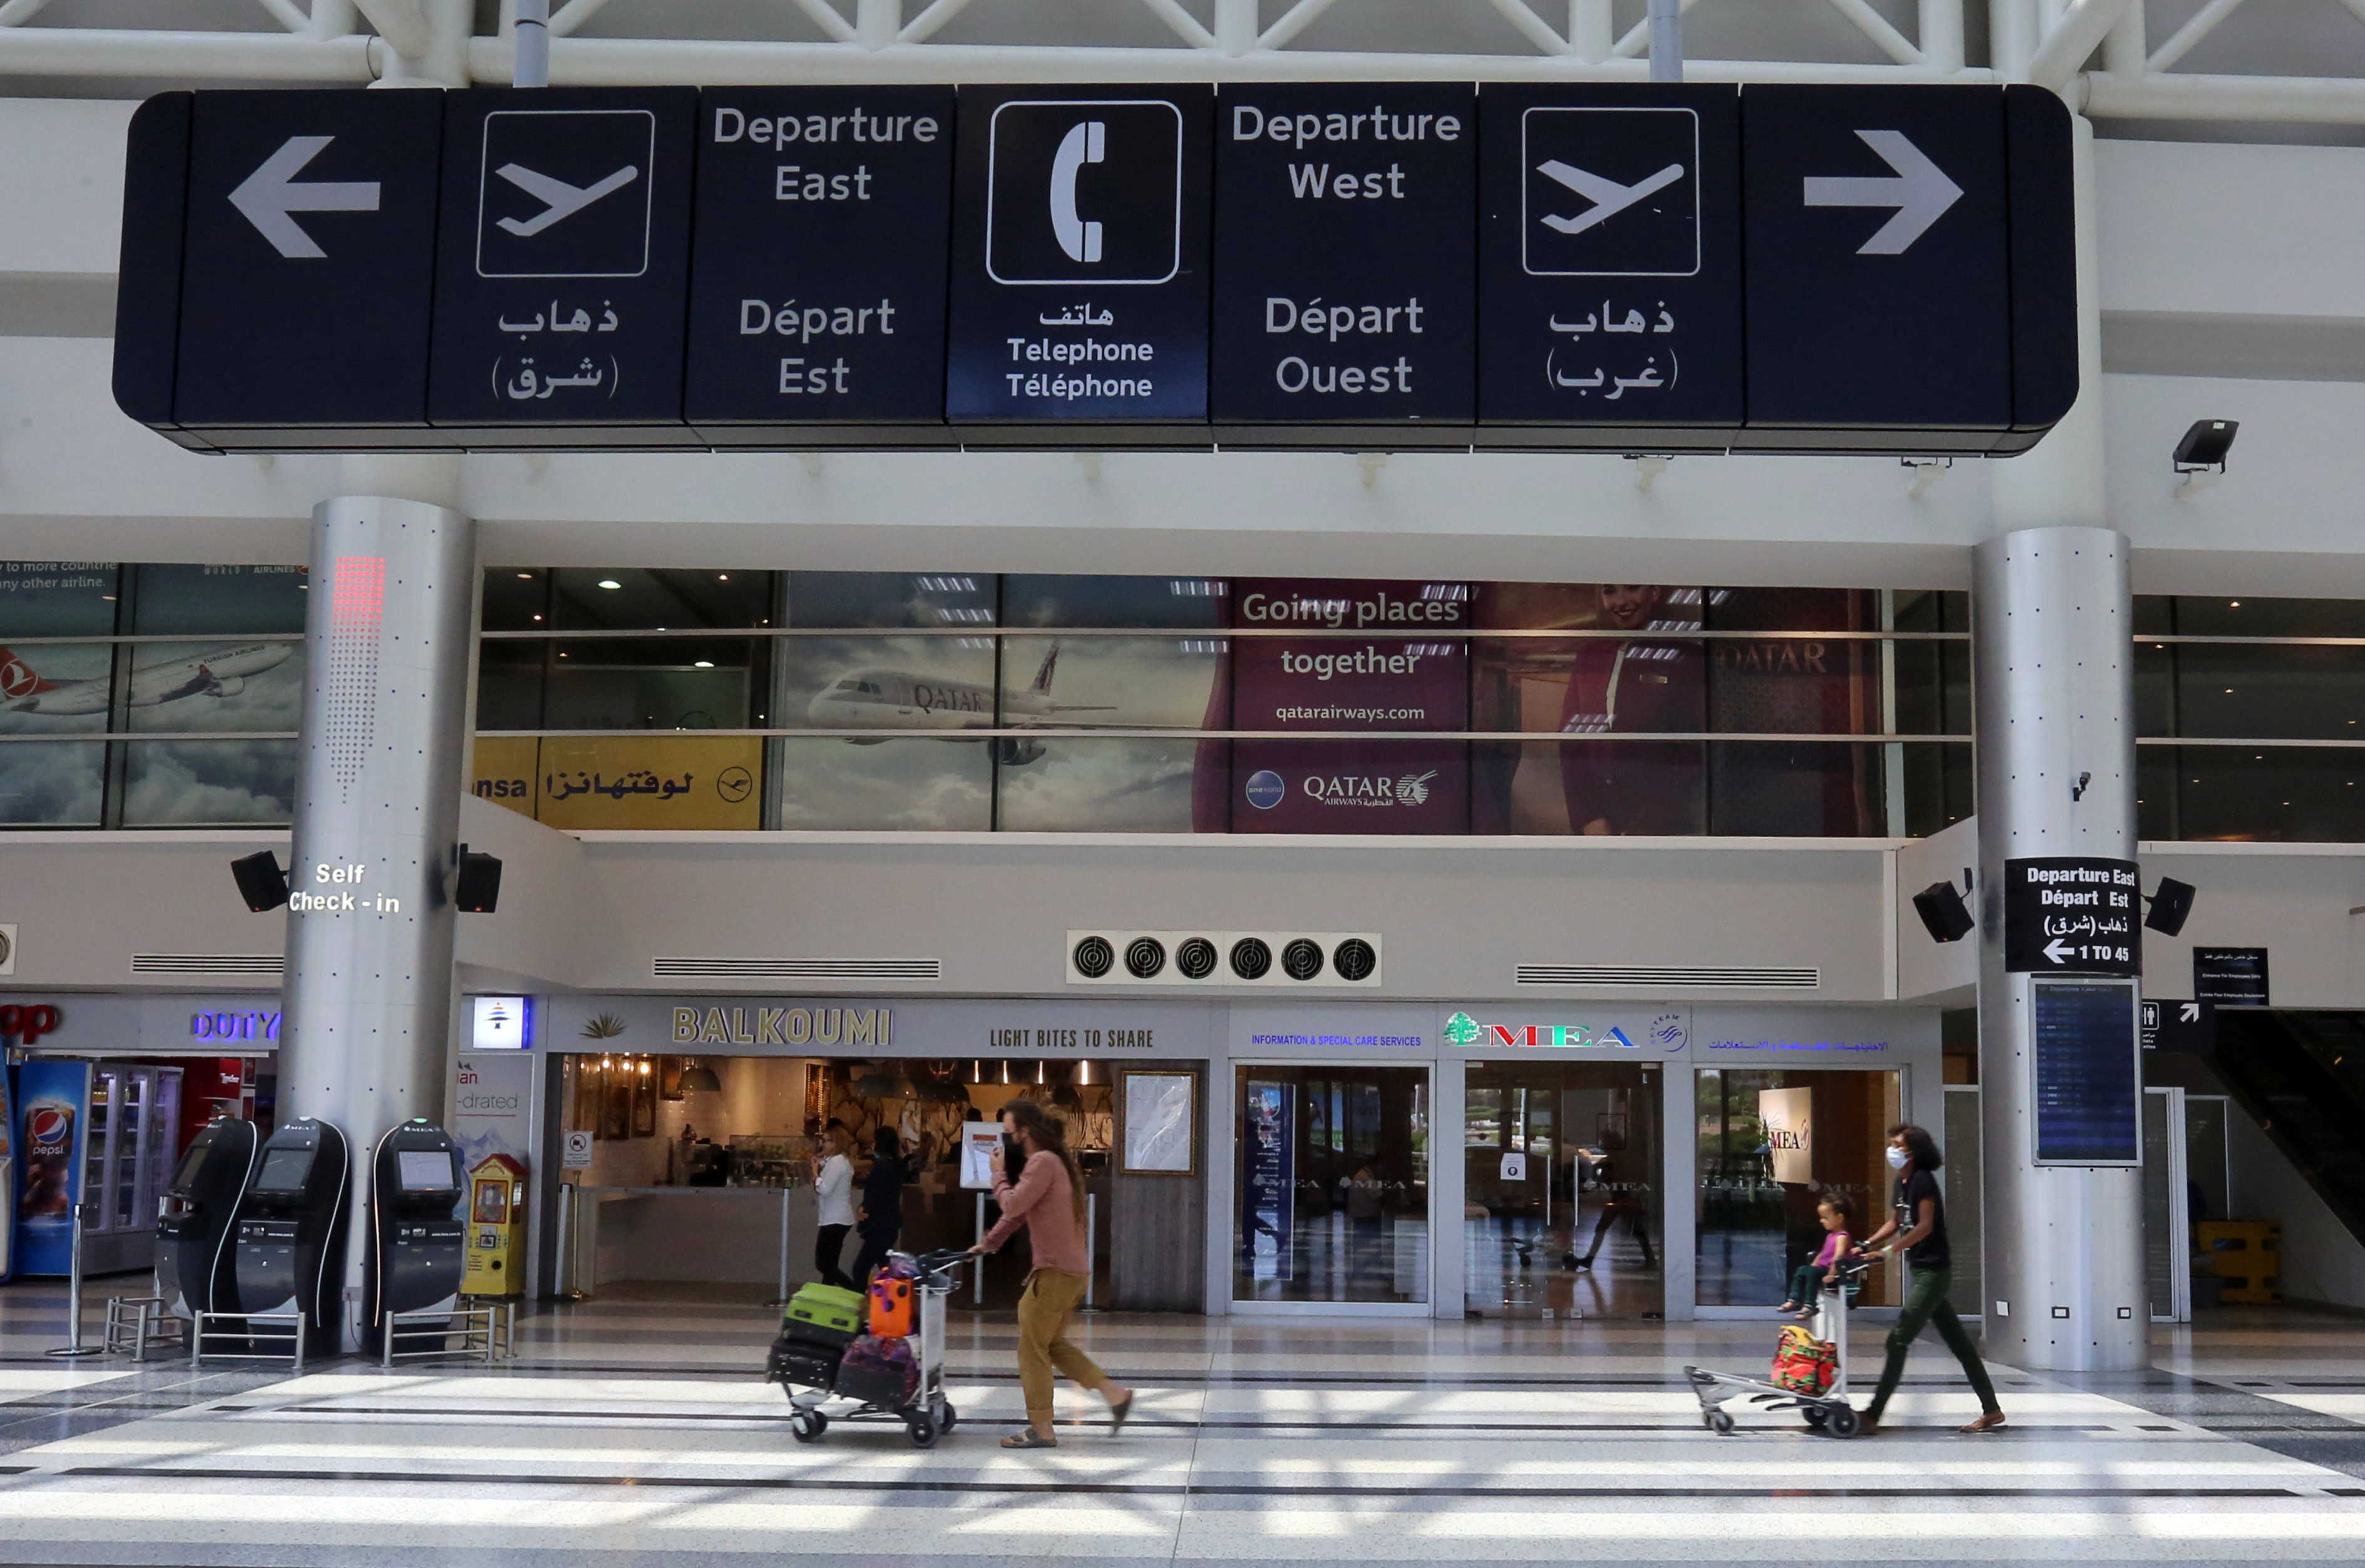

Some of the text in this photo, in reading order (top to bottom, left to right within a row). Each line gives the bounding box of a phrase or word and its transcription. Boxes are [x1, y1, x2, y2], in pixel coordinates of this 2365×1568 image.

[714, 107, 938, 151] Departure
[1233, 105, 1461, 150] Departure
[776, 165, 872, 201] East
[1288, 163, 1405, 200] West
[498, 300, 618, 341] ذهاب
[740, 299, 895, 344] Départ
[1039, 302, 1114, 326] هاتف
[1266, 297, 1424, 342] Départ
[1549, 299, 1675, 341] ذهاب
[1007, 338, 1154, 366] Telephone
[779, 357, 850, 394] Est
[1006, 373, 1153, 401] Téléphone
[1276, 356, 1413, 394] Ouest
[7, 563, 19, 571] to
[253, 565, 295, 573] AIRLINES
[22, 577, 58, 588] other
[61, 576, 106, 587] airline.
[1243, 592, 1459, 628] Going places
[1281, 646, 1420, 680] together
[915, 684, 982, 714] QATAR
[1276, 705, 1425, 723] qatarairways.com
[546, 771, 694, 800] لوفتهانزا
[1303, 776, 1393, 801] QATAR
[1324, 798, 1363, 806] AIRWAYS
[316, 863, 366, 884] Self
[2027, 867, 2135, 886] Departure East
[289, 891, 356, 911] Check
[2041, 889, 2129, 908] Départ Est
[2098, 916, 2128, 935] ذهاب
[2080, 945, 2129, 962] 1 TO 45
[191, 1013, 282, 1040] DUTY
[673, 1007, 893, 1045] BALKOUMI
[990, 1029, 1153, 1047] LIGHT BITES TO SHARE
[1482, 1024, 1641, 1048] MEA
[1251, 1035, 1422, 1047] INFORMATION & SPECIAL CARE SERVICES
[33, 1145, 63, 1156] pepsi
[1770, 1131, 1800, 1149] MEA
